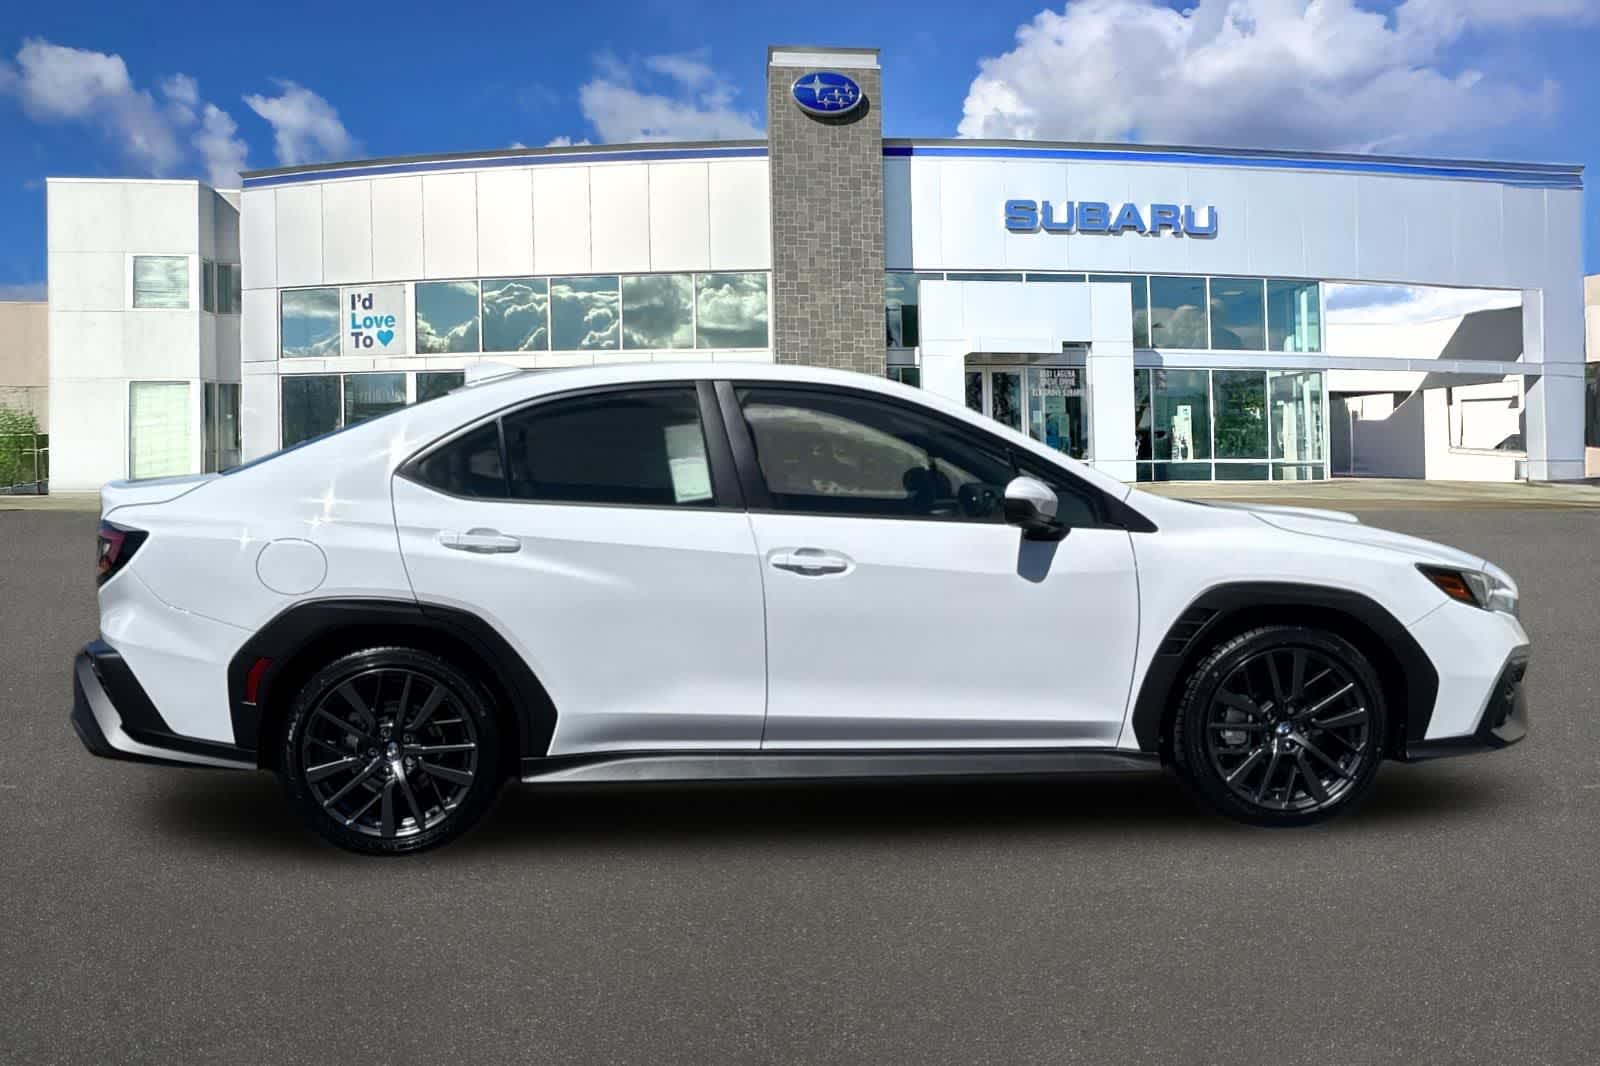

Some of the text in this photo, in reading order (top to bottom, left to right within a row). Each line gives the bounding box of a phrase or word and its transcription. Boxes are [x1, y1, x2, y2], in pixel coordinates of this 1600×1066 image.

[1004, 199, 1217, 238] SUBARU
[351, 293, 373, 310] I'd
[351, 312, 396, 329] Love
[351, 331, 373, 348] To
